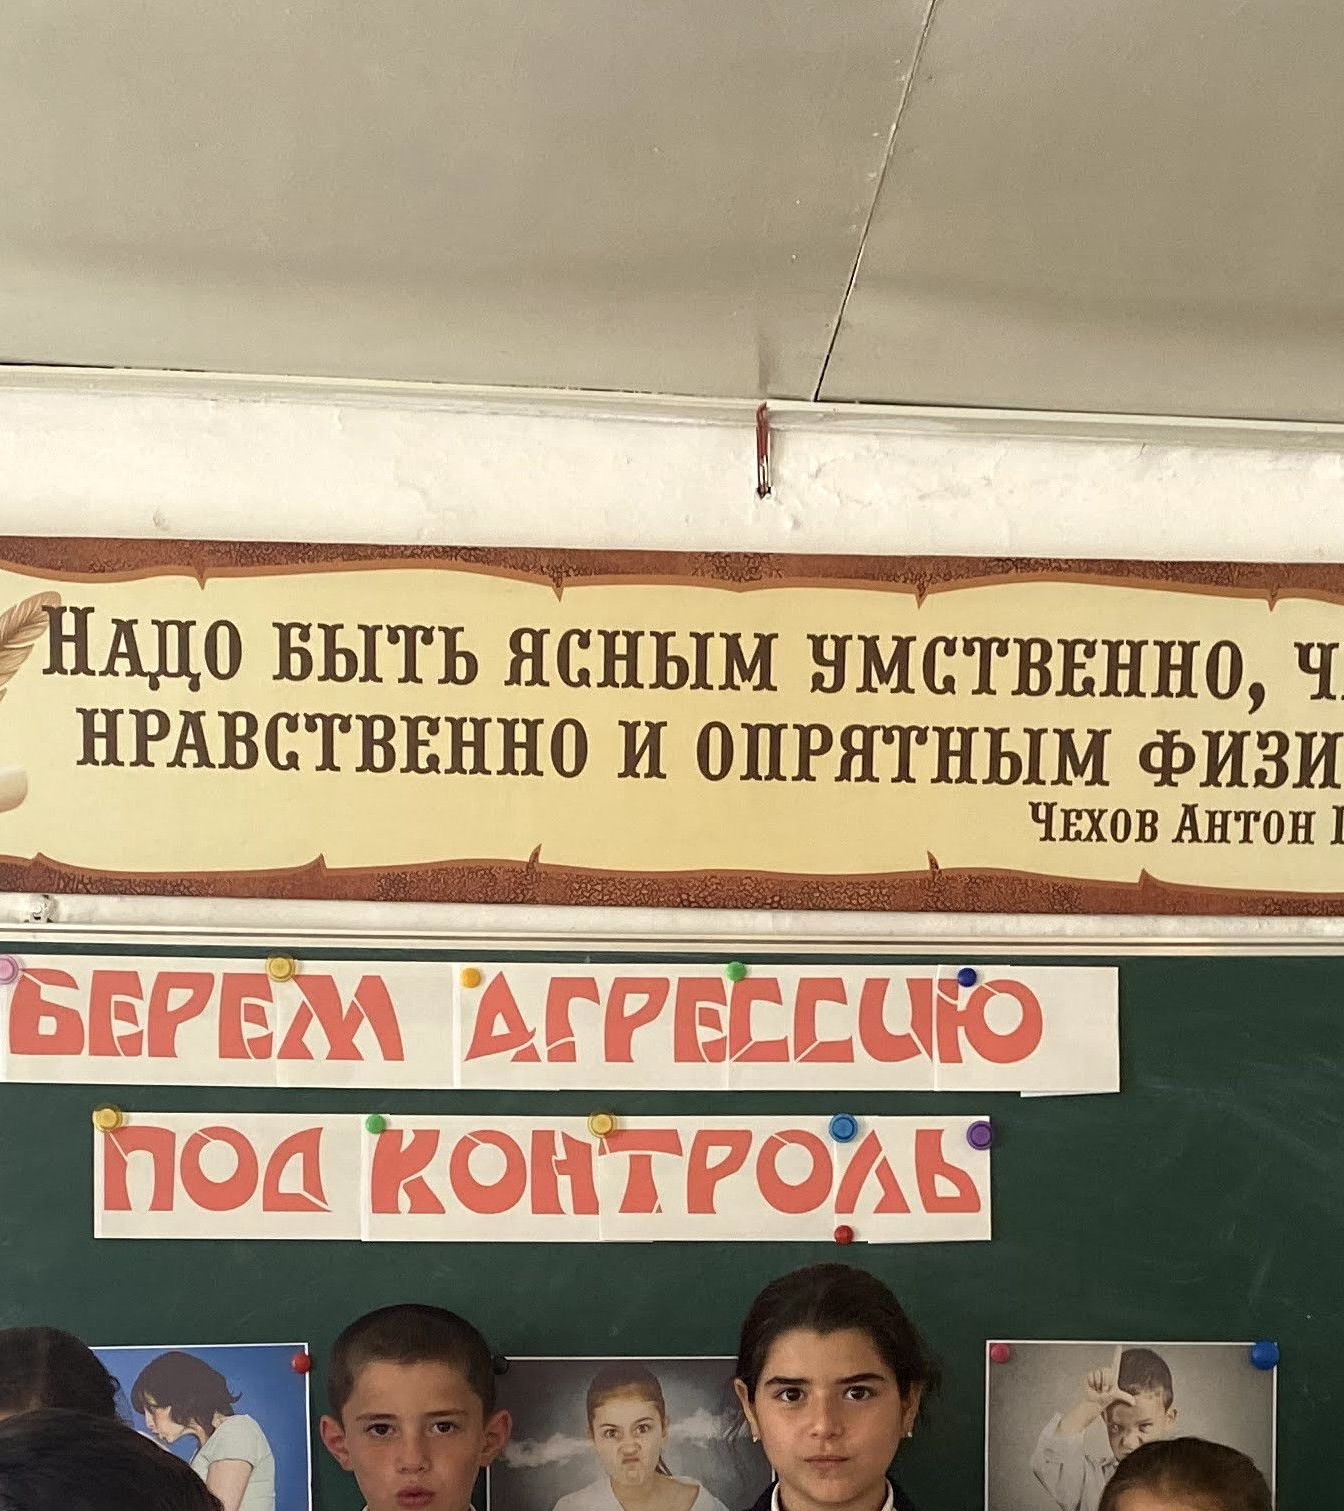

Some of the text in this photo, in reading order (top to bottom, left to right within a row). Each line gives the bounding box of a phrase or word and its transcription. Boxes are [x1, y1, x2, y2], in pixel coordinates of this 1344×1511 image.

[41, 604, 242, 693] НАДО
[272, 622, 479, 686] БЫТЬ
[504, 627, 779, 692] ЯСНЫМ
[806, 633, 1266, 715] УМСТВЕННО,
[75, 707, 588, 779] НРАВСТВЕННО
[617, 719, 668, 780] И
[696, 720, 1112, 787] ОПРЯТНЫМ
[9, 969, 1043, 1064] БЕРЕМ АГРЕССИЮ
[104, 1125, 981, 1216] ПОД КОНТРОЛЬ
